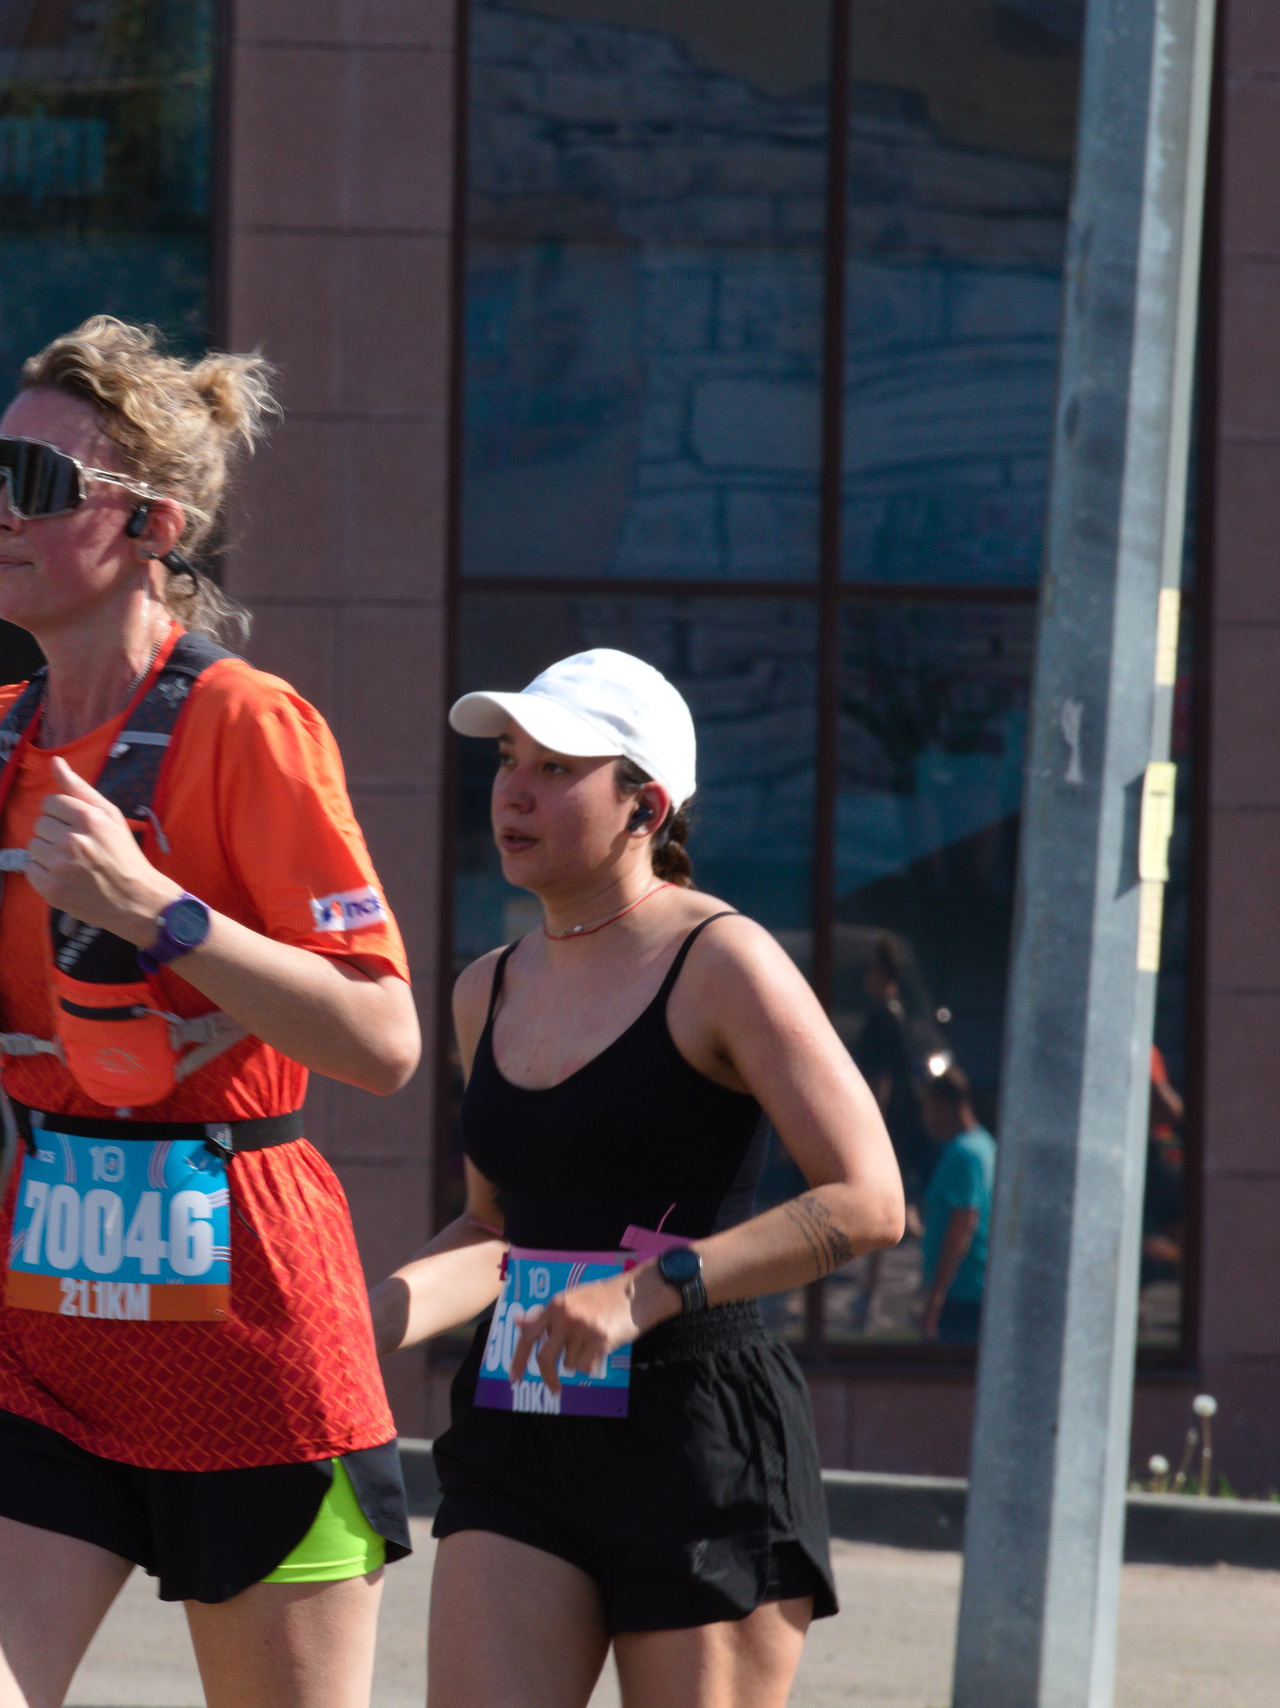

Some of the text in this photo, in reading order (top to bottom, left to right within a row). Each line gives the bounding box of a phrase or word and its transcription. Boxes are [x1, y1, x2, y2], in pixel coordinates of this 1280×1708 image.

[89, 1146, 126, 1183] 10
[23, 1179, 215, 1277] 70046
[528, 1266, 551, 1299] 10
[511, 1380, 561, 1415] 10KM
